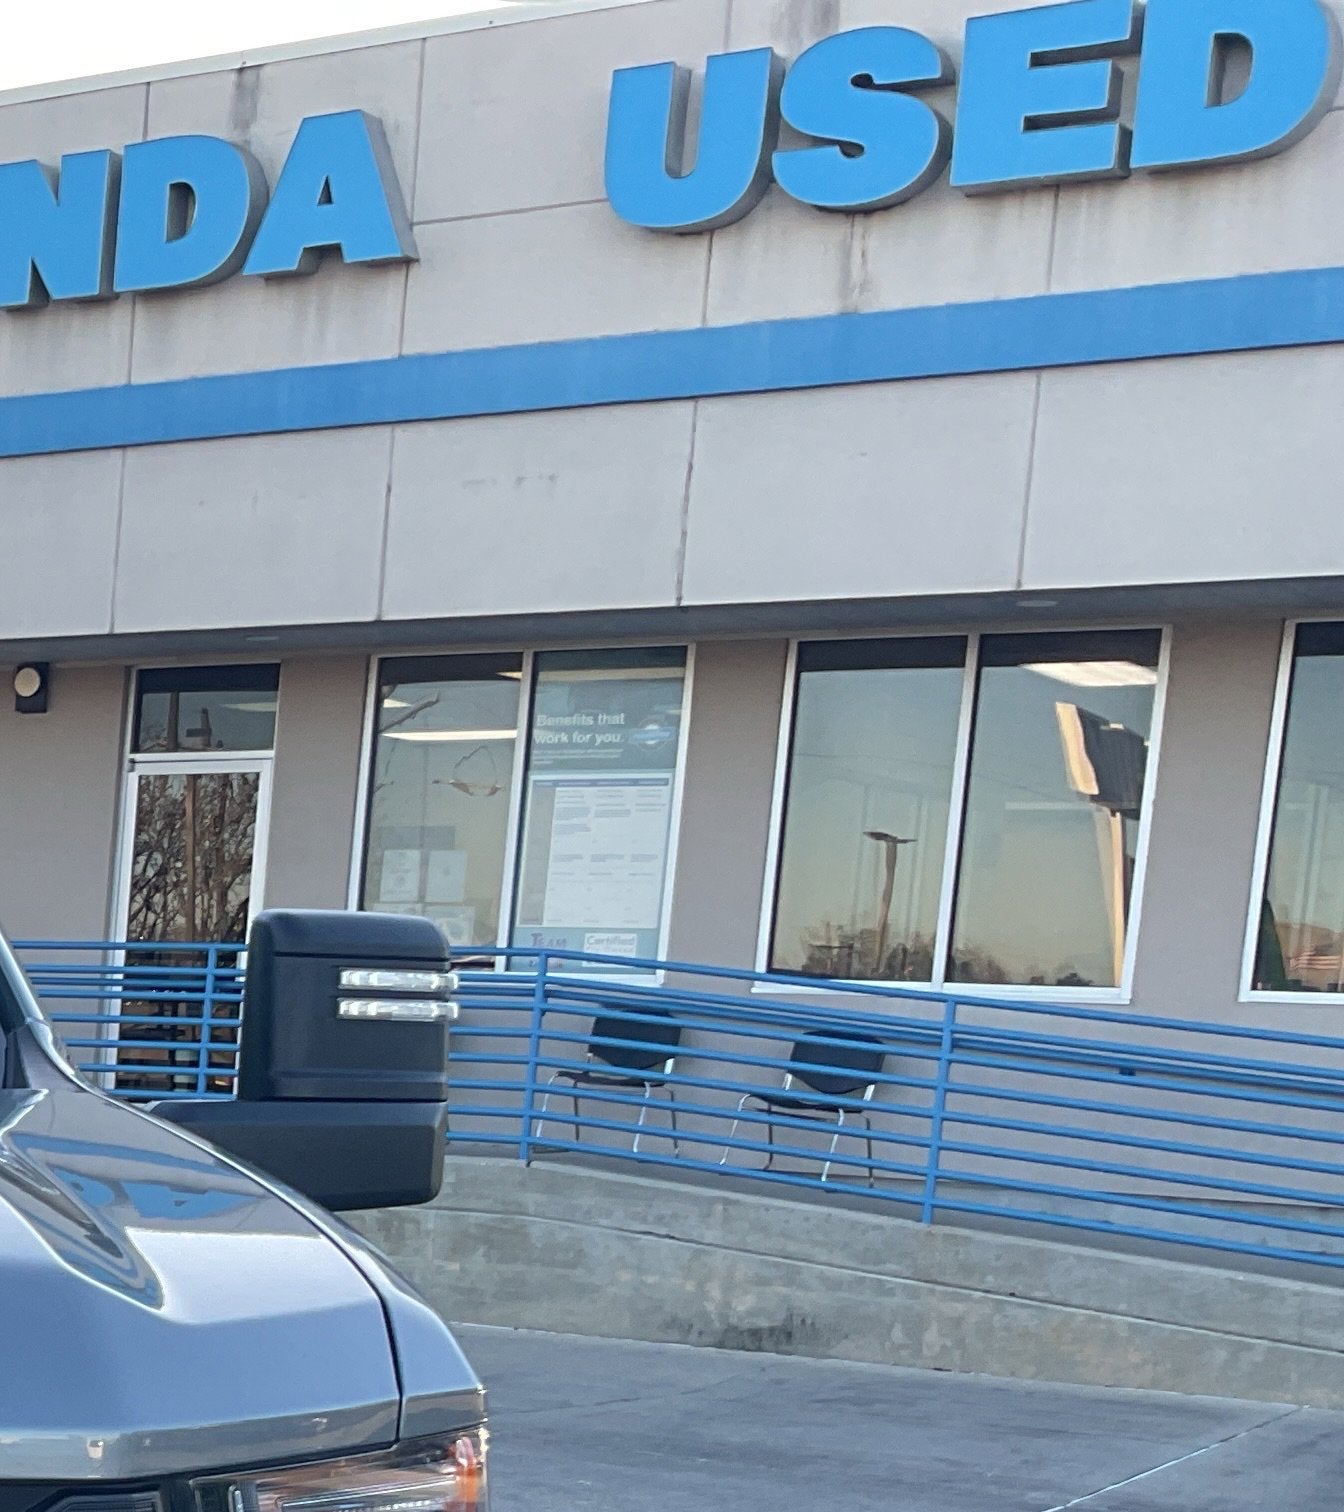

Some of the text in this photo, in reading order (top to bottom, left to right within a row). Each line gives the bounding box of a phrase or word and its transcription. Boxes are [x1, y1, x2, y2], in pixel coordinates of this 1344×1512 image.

[604, 0, 1342, 234] USED
[536, 712, 625, 727] Benefits that
[534, 732, 569, 744] work
[572, 731, 591, 743] for
[594, 732, 624, 746] you.
